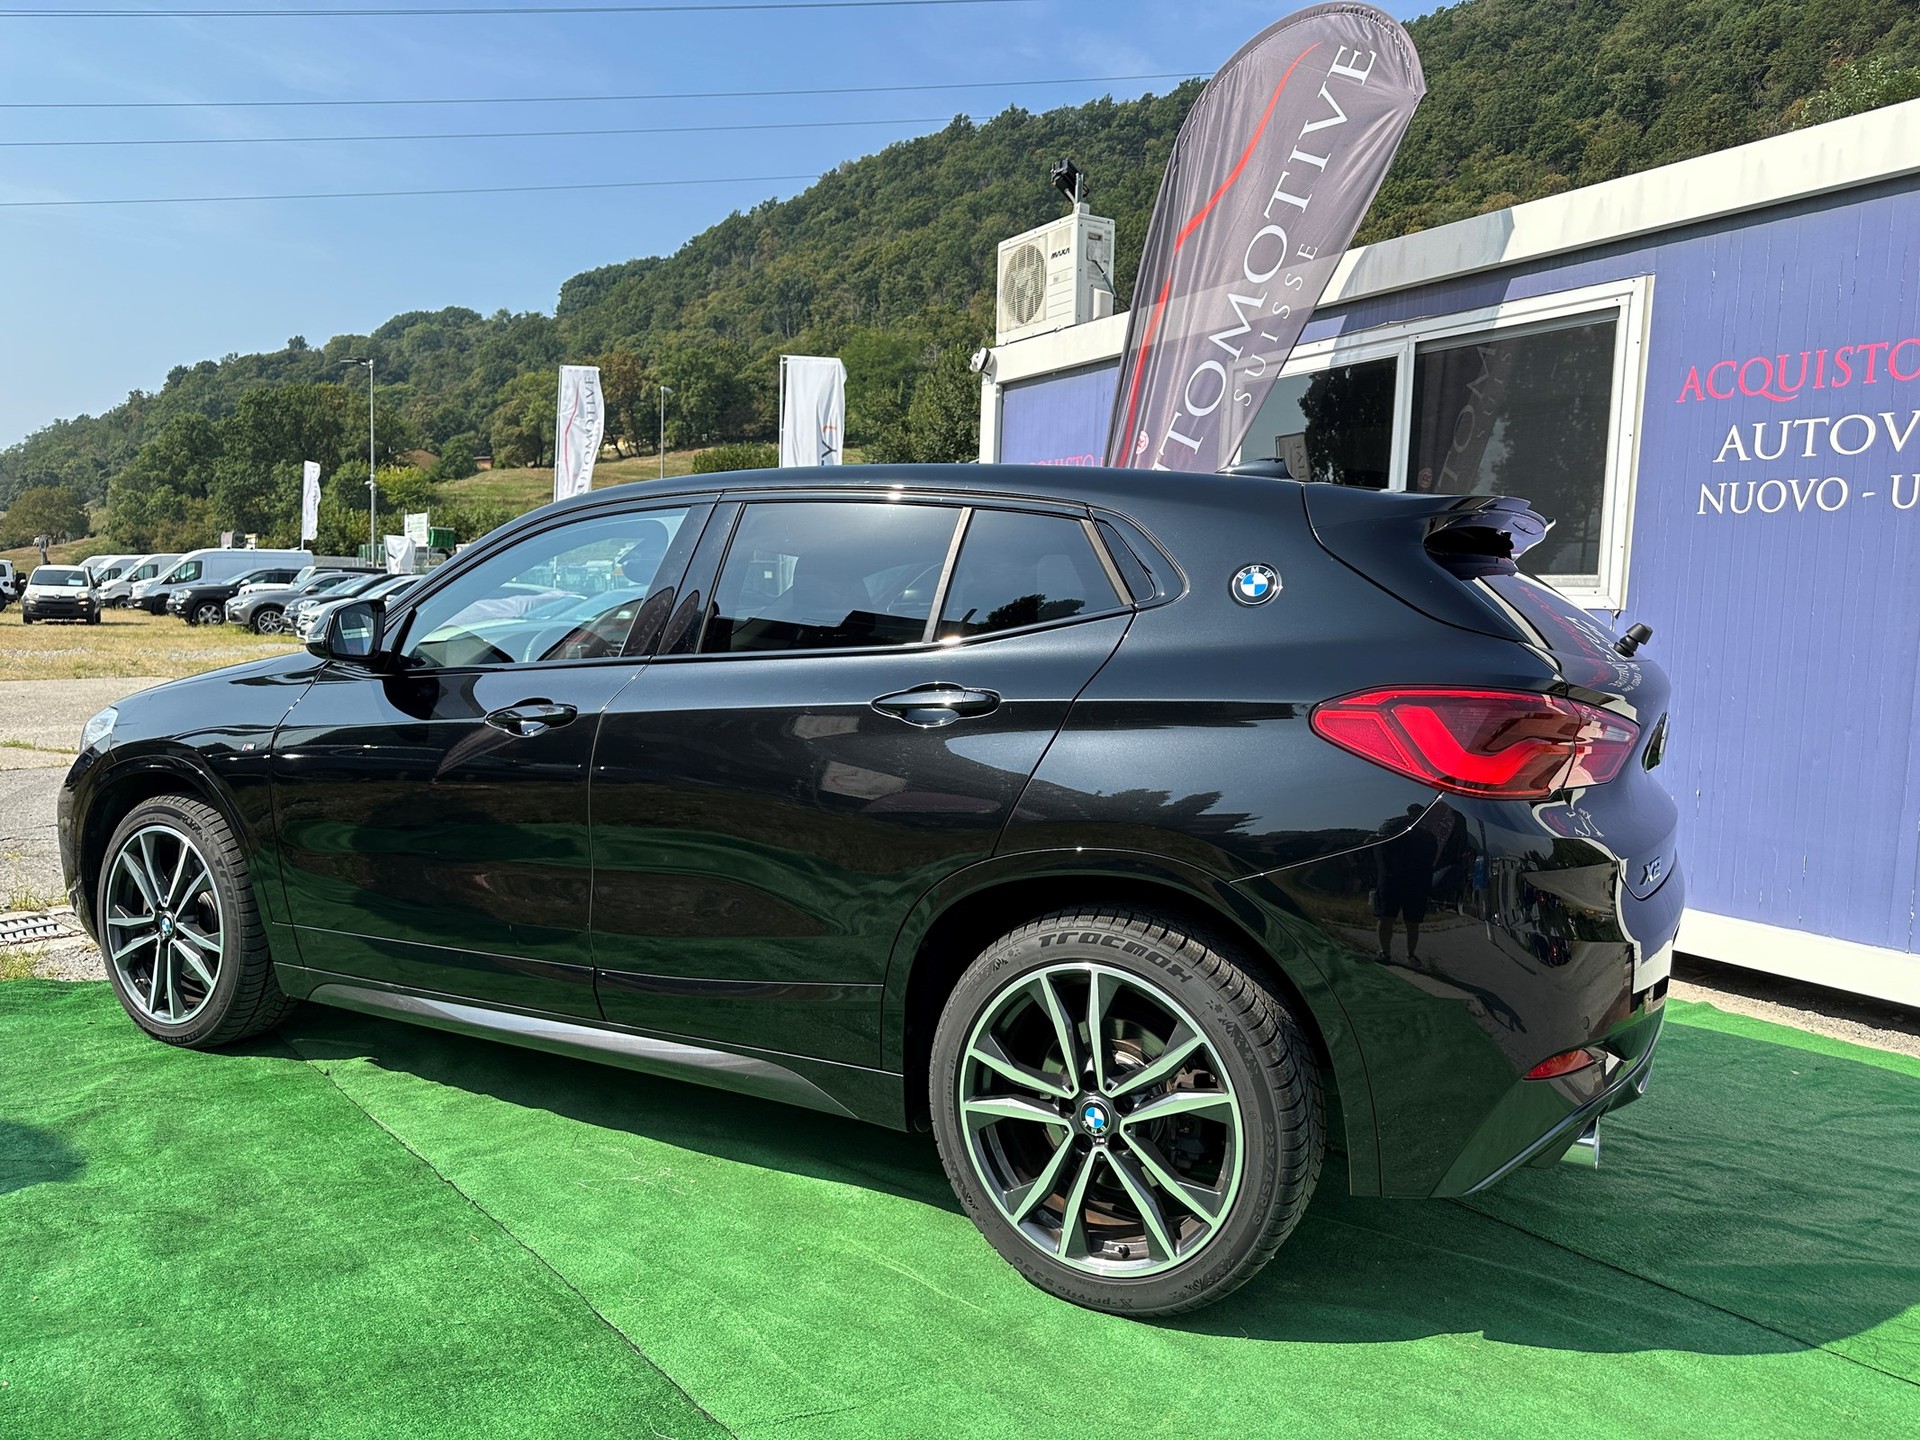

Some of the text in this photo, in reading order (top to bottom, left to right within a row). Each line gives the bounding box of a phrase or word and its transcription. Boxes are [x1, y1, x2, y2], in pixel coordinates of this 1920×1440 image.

[1152, 45, 1377, 471] TOMOTIVE
[1233, 243, 1319, 407] SUISSE
[1675, 338, 1920, 403] ACQUISTO
[1712, 410, 1920, 463] AUTOV
[1697, 477, 1849, 515] NUOVO
[1639, 856, 1661, 886] X2
[1252, 1121, 1275, 1226] 225/45R19
